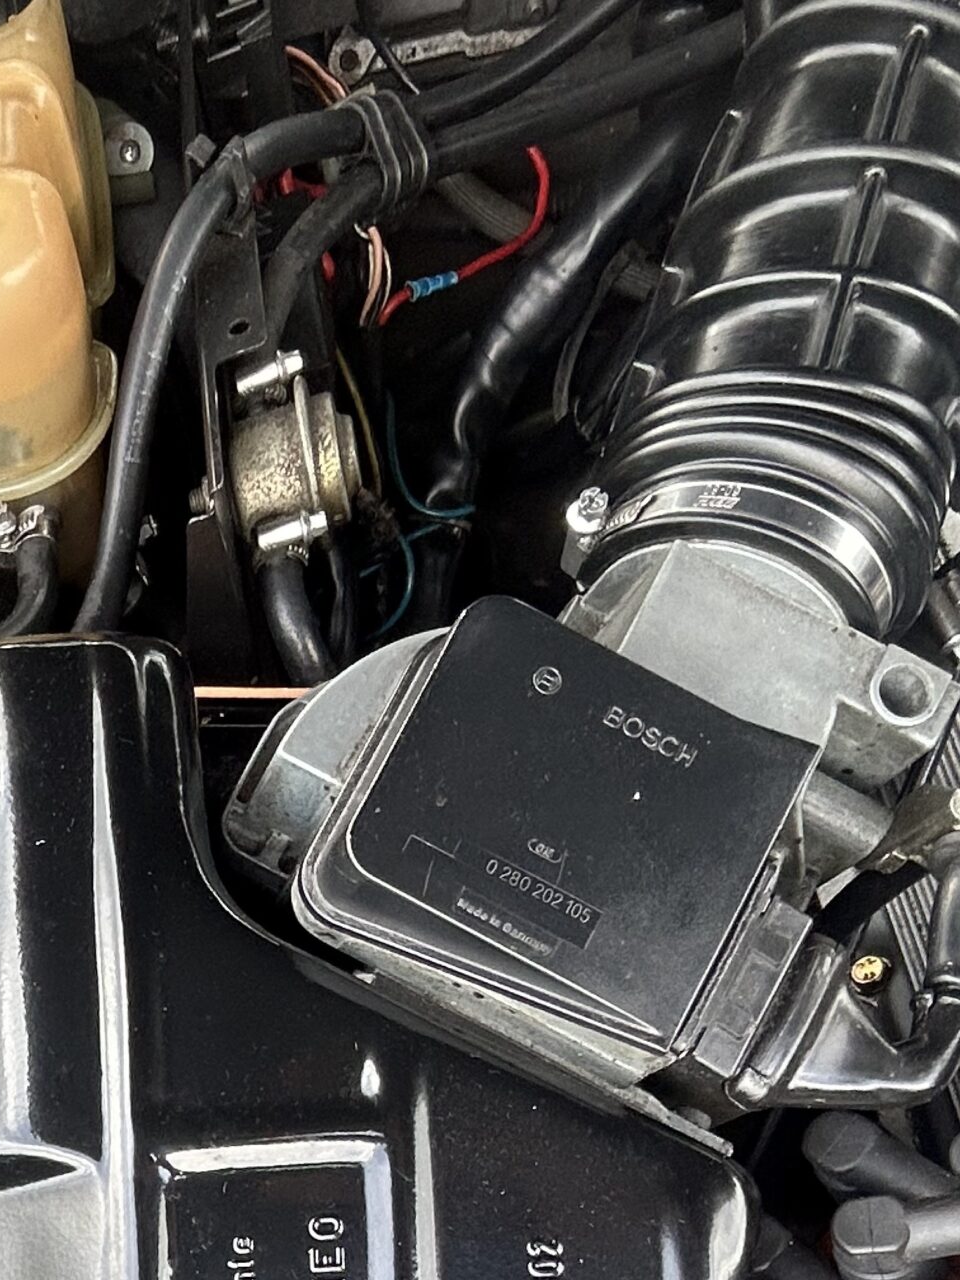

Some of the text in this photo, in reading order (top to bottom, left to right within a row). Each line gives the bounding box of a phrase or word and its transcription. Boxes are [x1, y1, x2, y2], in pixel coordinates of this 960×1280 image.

[603, 705, 698, 768] BOSCH
[485, 859, 592, 924] 0 280 202 105
